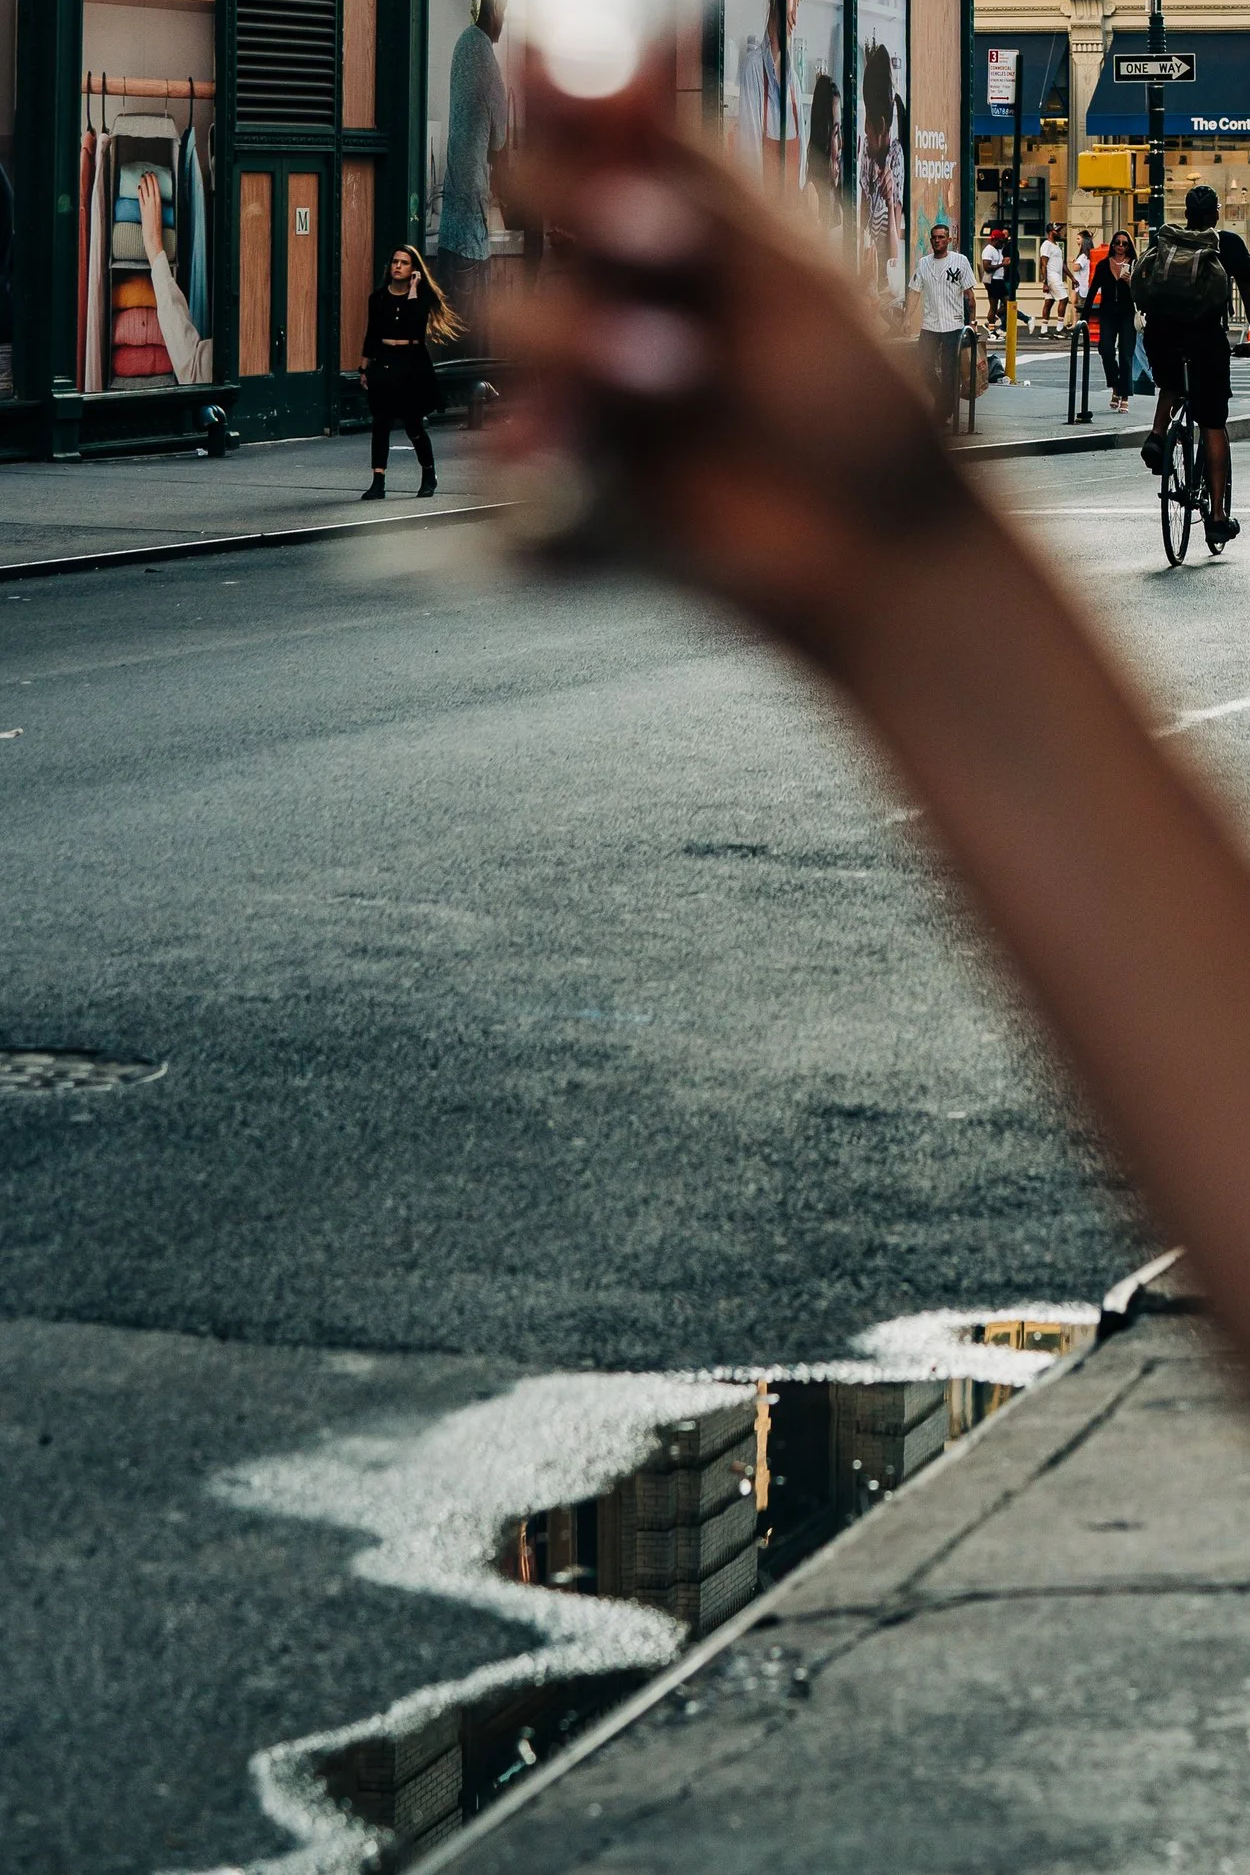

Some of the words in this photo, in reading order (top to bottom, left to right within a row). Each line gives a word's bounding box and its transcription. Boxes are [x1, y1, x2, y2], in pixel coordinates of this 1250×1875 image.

[991, 51, 997, 62] 3
[1126, 62, 1149, 74] ONE
[1158, 62, 1183, 73] WAY
[1191, 117, 1217, 130] The
[915, 125, 948, 154] home,
[915, 154, 955, 185] happier
[298, 211, 308, 231] M
[946, 267, 960, 284] NY
